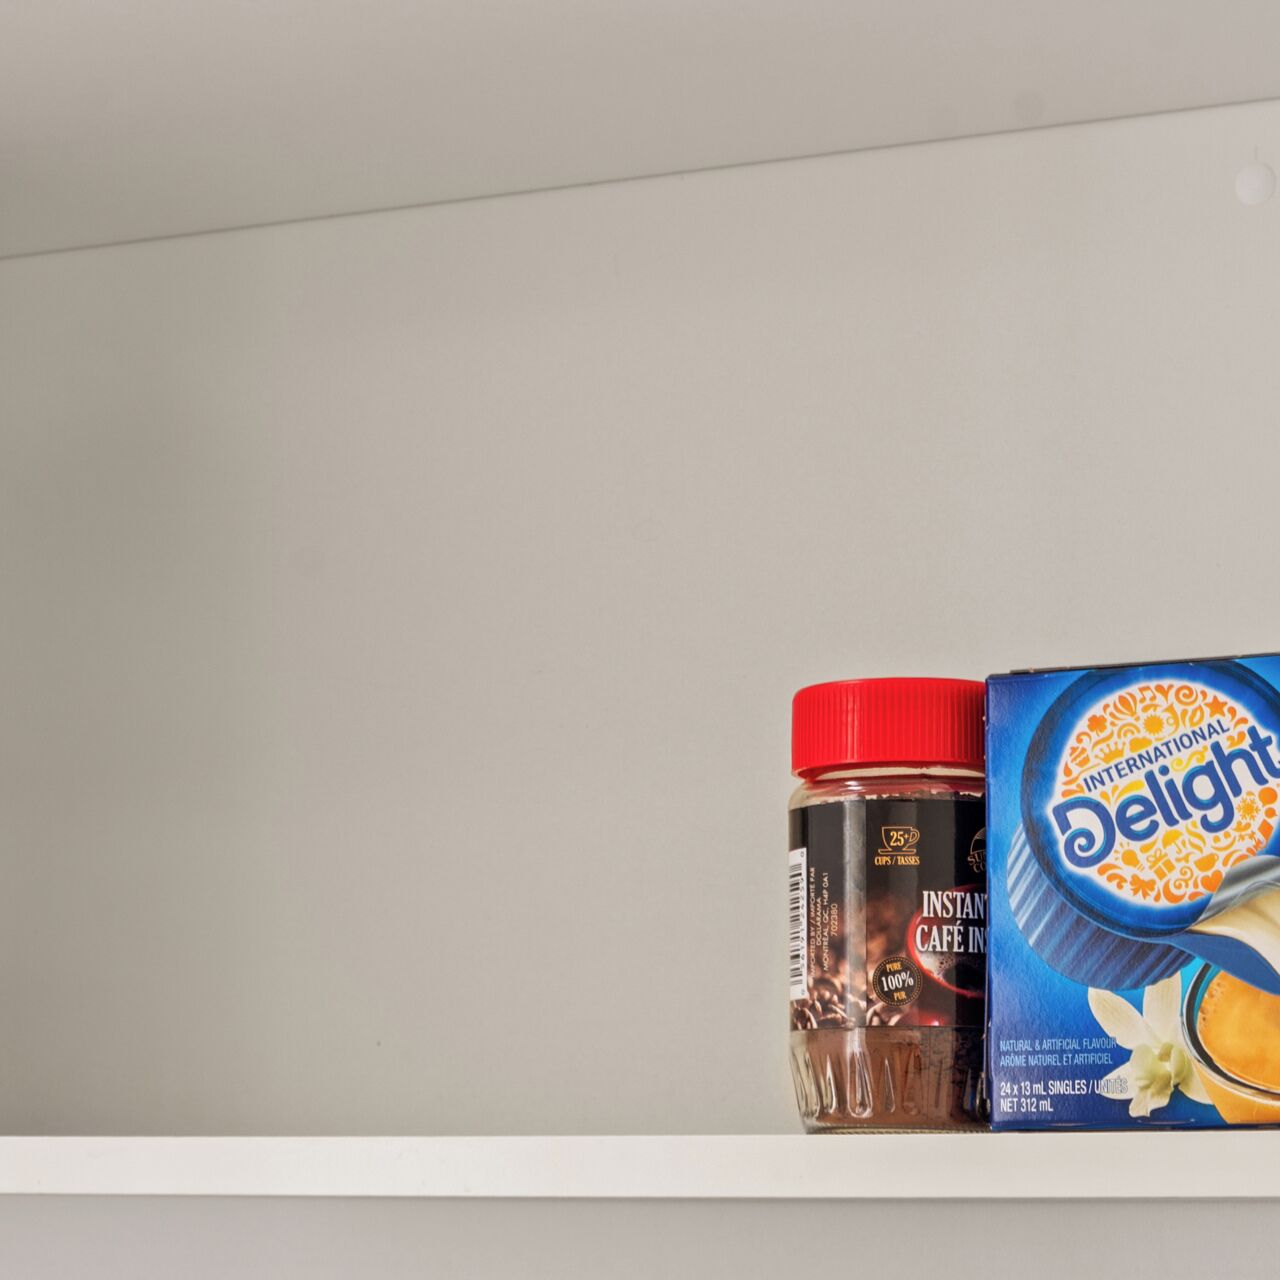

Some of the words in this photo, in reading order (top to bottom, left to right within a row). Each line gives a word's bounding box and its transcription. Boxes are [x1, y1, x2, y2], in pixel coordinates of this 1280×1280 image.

[1083, 719, 1230, 792] INTERNATIONAL
[875, 856, 891, 865] CUPS
[897, 856, 920, 865] TASSES
[916, 921, 964, 953] CAFÉ
[886, 962, 902, 972] PURE
[881, 971, 914, 992] 100%
[1000, 1040, 1032, 1052] NATURAL
[1035, 1041, 1040, 1051] &
[1042, 1039, 1080, 1050] ARTIFICIAL
[1000, 1053, 1027, 1067] ARÔME
[1029, 1055, 1061, 1066] NATUREL
[1063, 1054, 1072, 1065] ET
[1074, 1053, 1113, 1064] ARTIFICIEL
[1000, 1082, 1011, 1096] 24
[1013, 1085, 1019, 1096] x
[1021, 1082, 1031, 1095] 13
[1033, 1081, 1046, 1095] mL
[1048, 1080, 1087, 1094] SINGLES
[1000, 1098, 1018, 1112] NET
[1021, 1098, 1037, 1112] 312
[1039, 1097, 1054, 1112] mL
